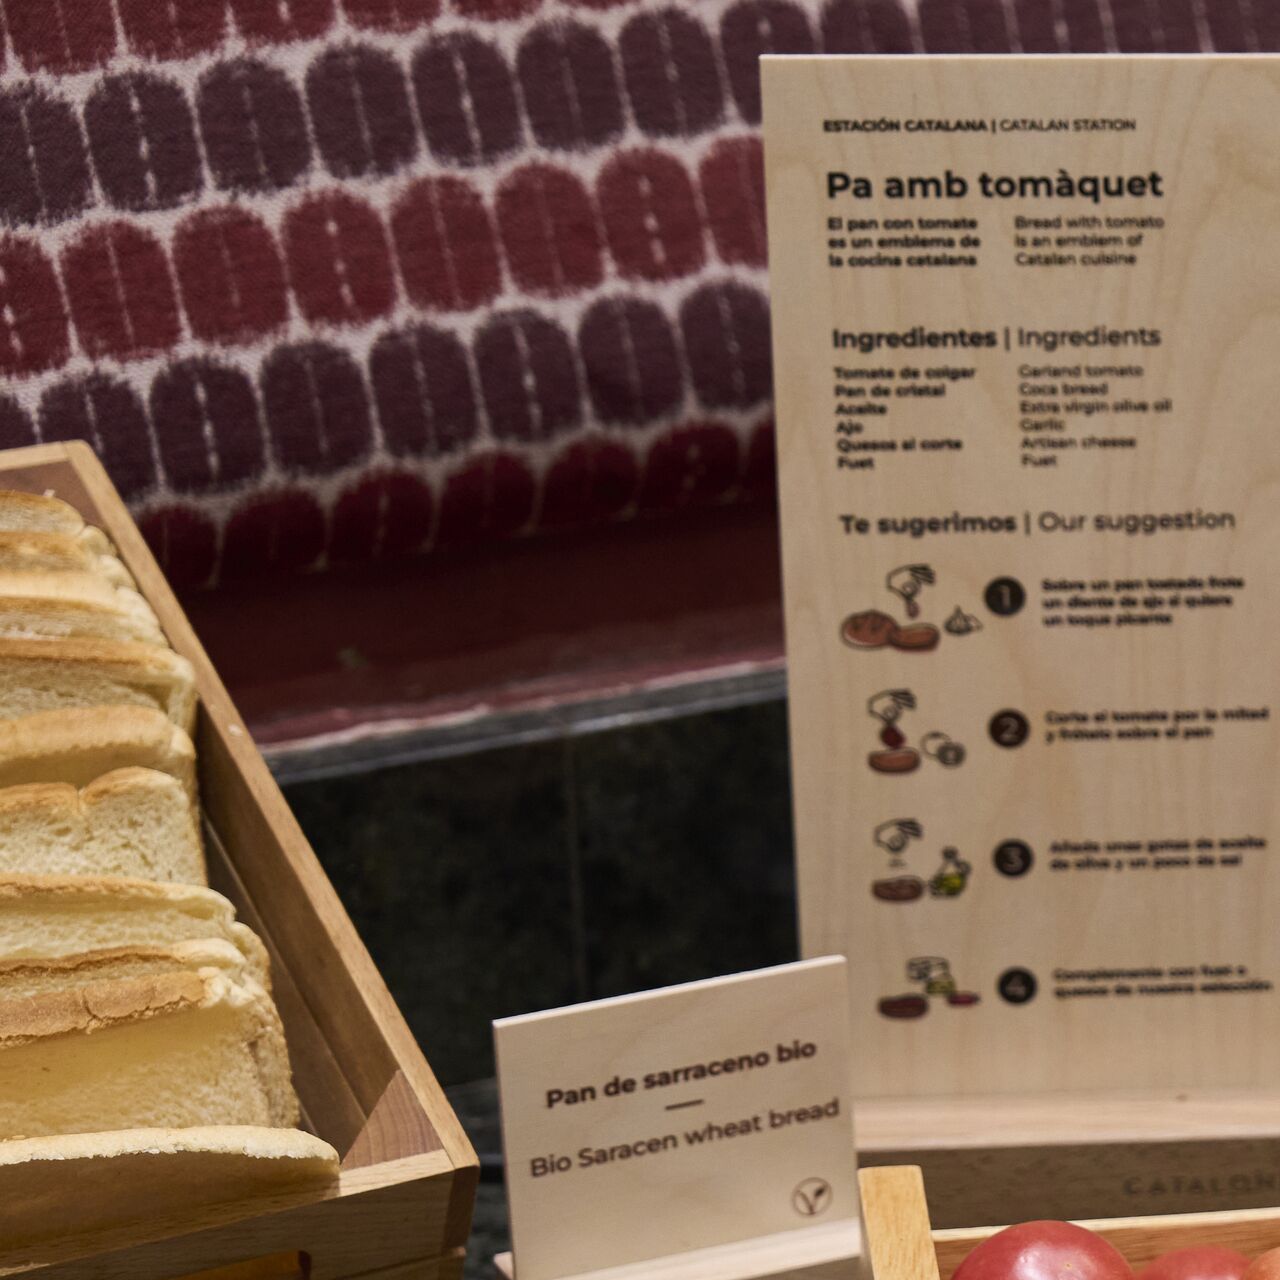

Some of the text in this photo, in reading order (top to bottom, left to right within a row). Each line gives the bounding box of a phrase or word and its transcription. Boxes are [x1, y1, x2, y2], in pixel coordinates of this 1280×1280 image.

[822, 117, 1136, 133] ESTACIÓN CATALANA CATALAN STATION
[826, 169, 1164, 203] Pa amb tomàquet
[832, 325, 1162, 354] Ingredientes Ingredients
[838, 508, 1236, 539] Te sugerimos Our suggestion
[547, 1039, 818, 1109] Pan de sarraceno bio
[530, 1097, 841, 1178] Bio Saracen wheat bread
